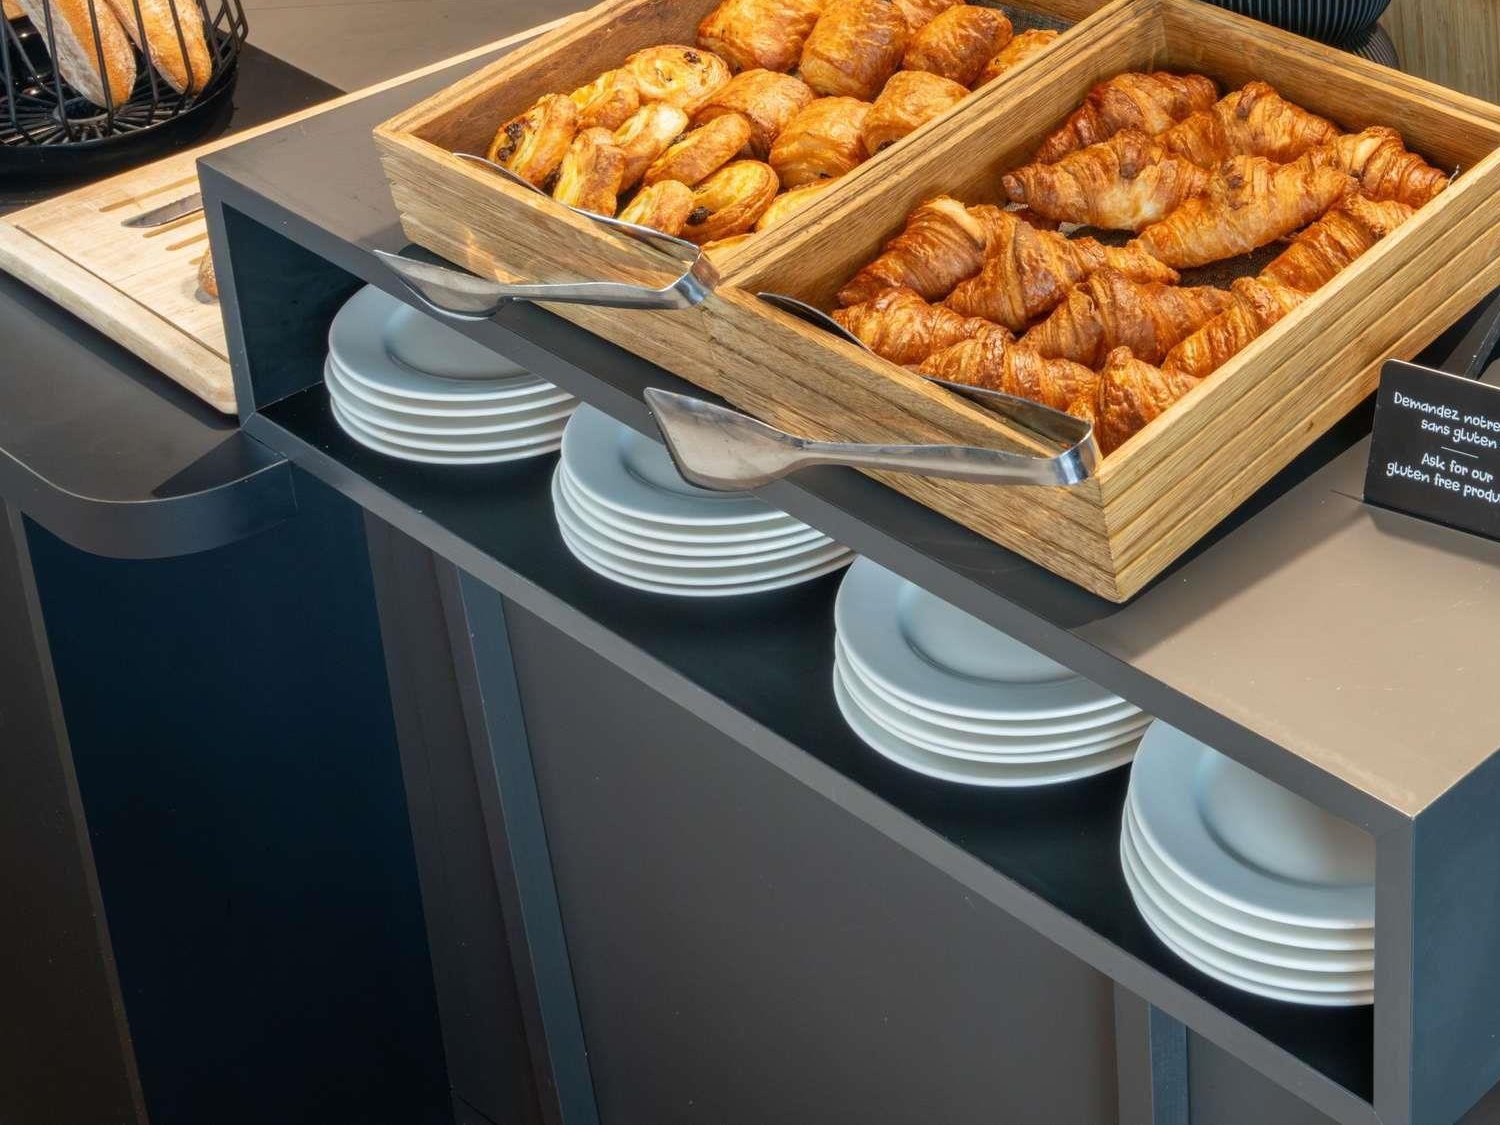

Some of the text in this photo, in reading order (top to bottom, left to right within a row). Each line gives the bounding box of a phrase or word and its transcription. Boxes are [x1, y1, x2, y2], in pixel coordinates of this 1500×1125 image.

[1394, 391, 1460, 421] Demandez
[1464, 414, 1500, 432] notre
[1421, 418, 1450, 435] sans
[1452, 427, 1498, 449] gluten
[1386, 461, 1430, 484] gluten
[1433, 473, 1461, 492] free
[1421, 452, 1494, 483] Ask for our
